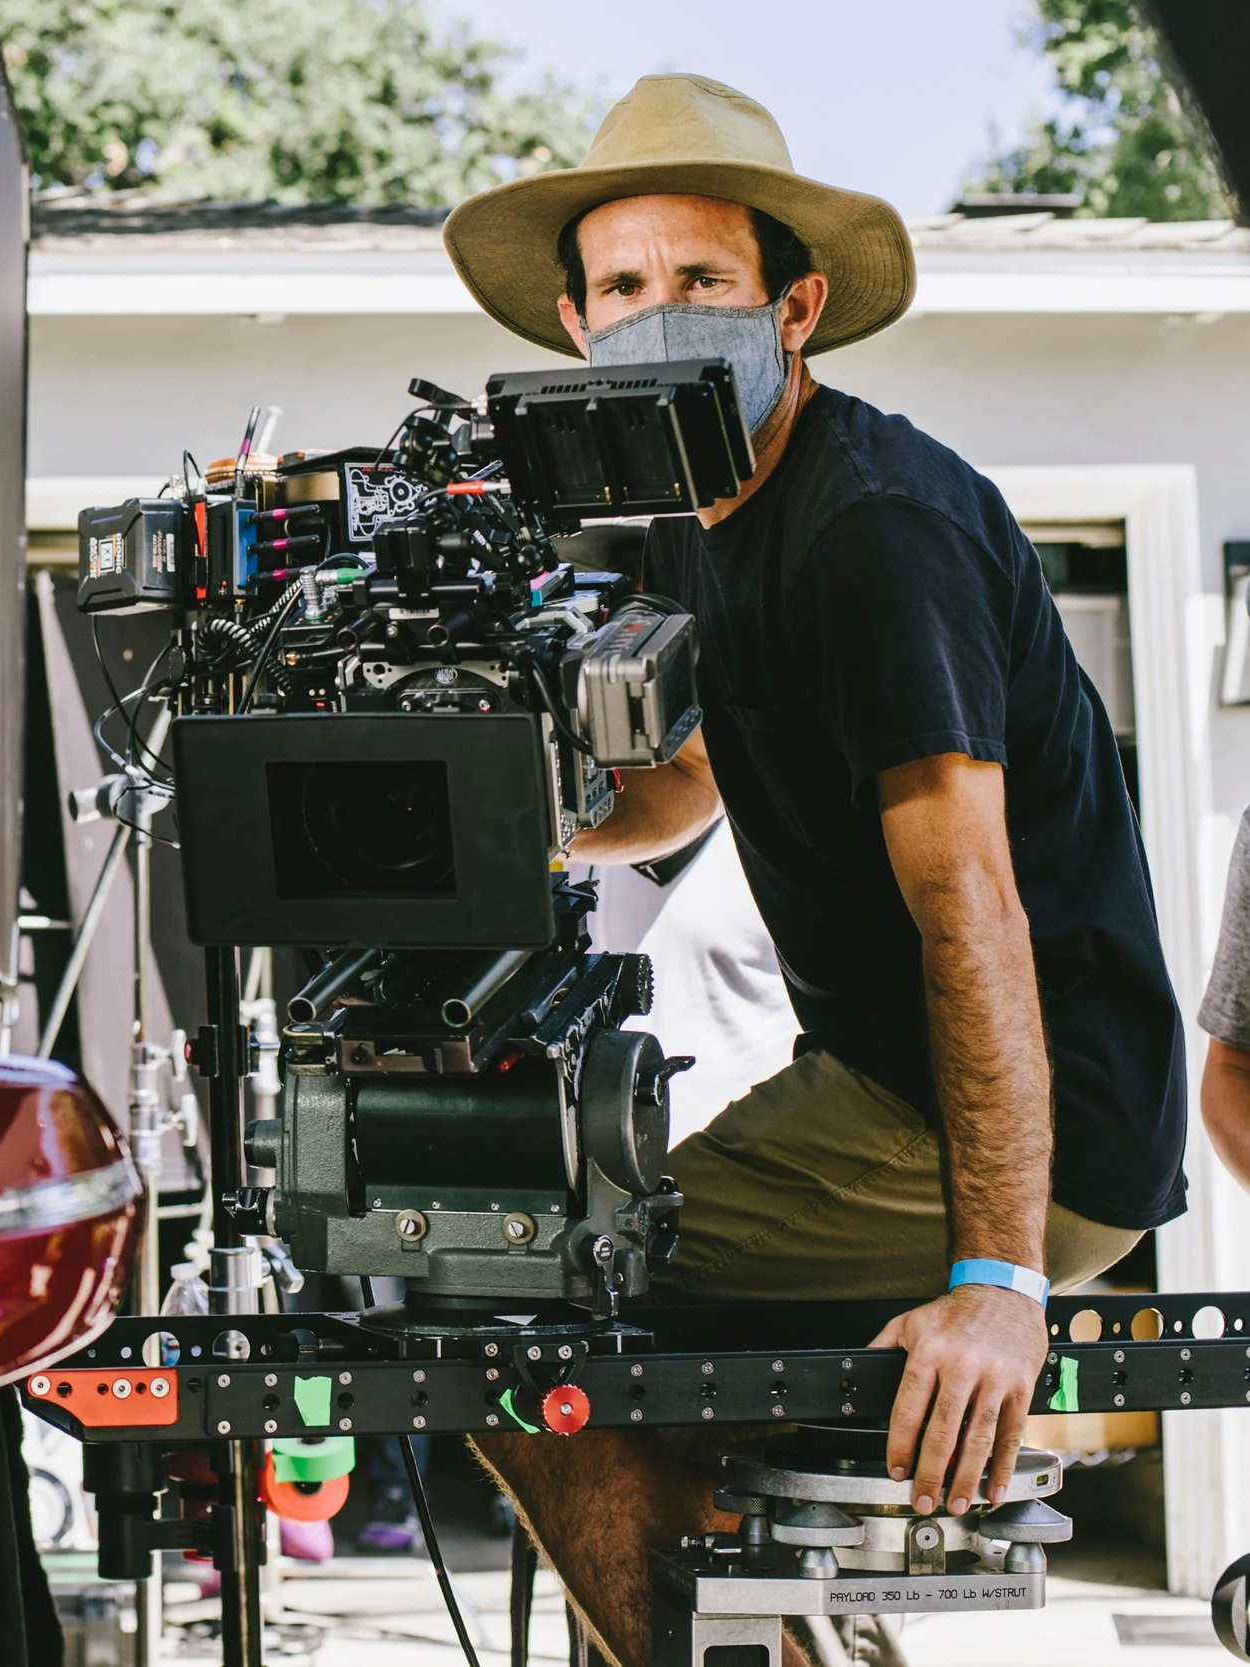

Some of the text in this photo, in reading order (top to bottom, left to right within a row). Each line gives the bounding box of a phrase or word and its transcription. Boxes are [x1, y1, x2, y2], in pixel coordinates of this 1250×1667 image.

[830, 1591, 876, 1602] PAYLOAD
[882, 1590, 901, 1601] 350
[906, 1590, 920, 1600] Lb
[938, 1589, 958, 1599] 700
[963, 1589, 977, 1599] Lb
[982, 1587, 1027, 1598] W/STRUT
